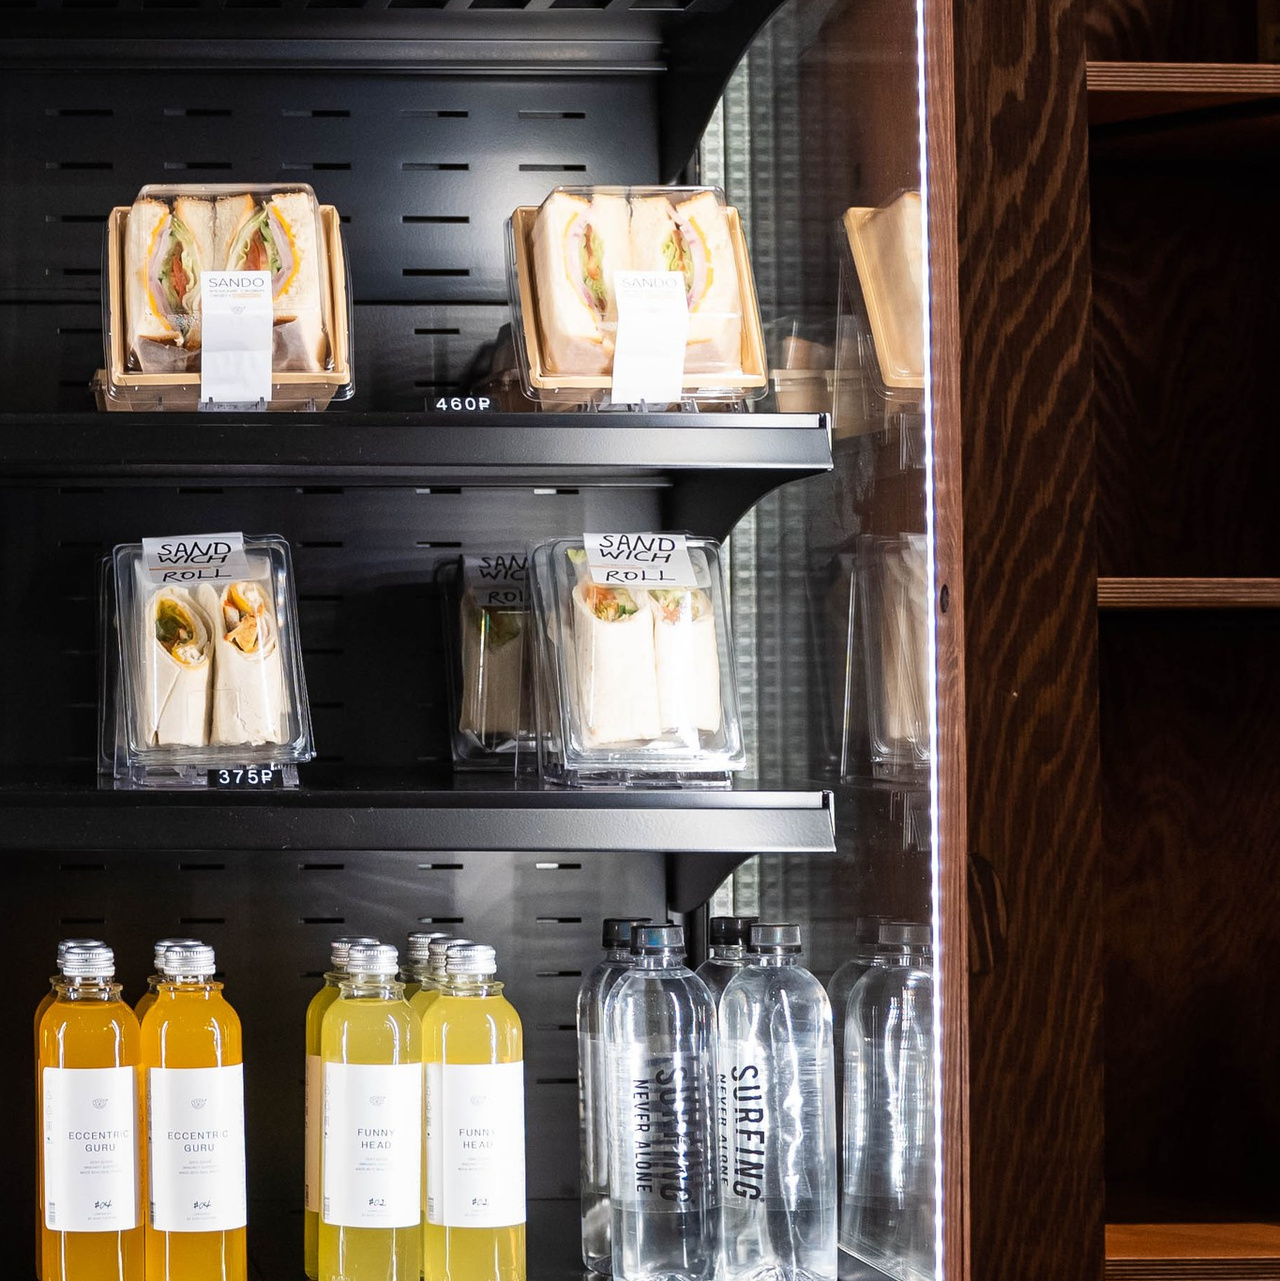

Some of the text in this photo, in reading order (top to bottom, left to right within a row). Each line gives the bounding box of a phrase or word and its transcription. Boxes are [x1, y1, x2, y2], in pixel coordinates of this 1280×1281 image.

[208, 277, 265, 288] SANDO
[622, 277, 677, 288] SANDO
[599, 534, 676, 552] SAND
[157, 541, 232, 557] SAND
[158, 554, 227, 564] WICH
[600, 549, 672, 563] WICH
[478, 555, 528, 570] SAN
[163, 569, 232, 582] ROLL
[480, 568, 528, 581] WIC
[606, 569, 676, 582] ROLL
[68, 1130, 129, 1140] ECCENTRIC
[168, 1130, 229, 1140] ECCENTRIC
[357, 1128, 395, 1137] FUNNY
[459, 1128, 495, 1136] FUNNY
[633, 1079, 652, 1192] NEVER ALONE
[731, 1065, 765, 1201] SURFING
[85, 1143, 116, 1152] GURU
[184, 1143, 215, 1152] GURU
[361, 1141, 392, 1149] HEAD
[463, 1141, 493, 1149] HEAD
[368, 1198, 386, 1206] #02
